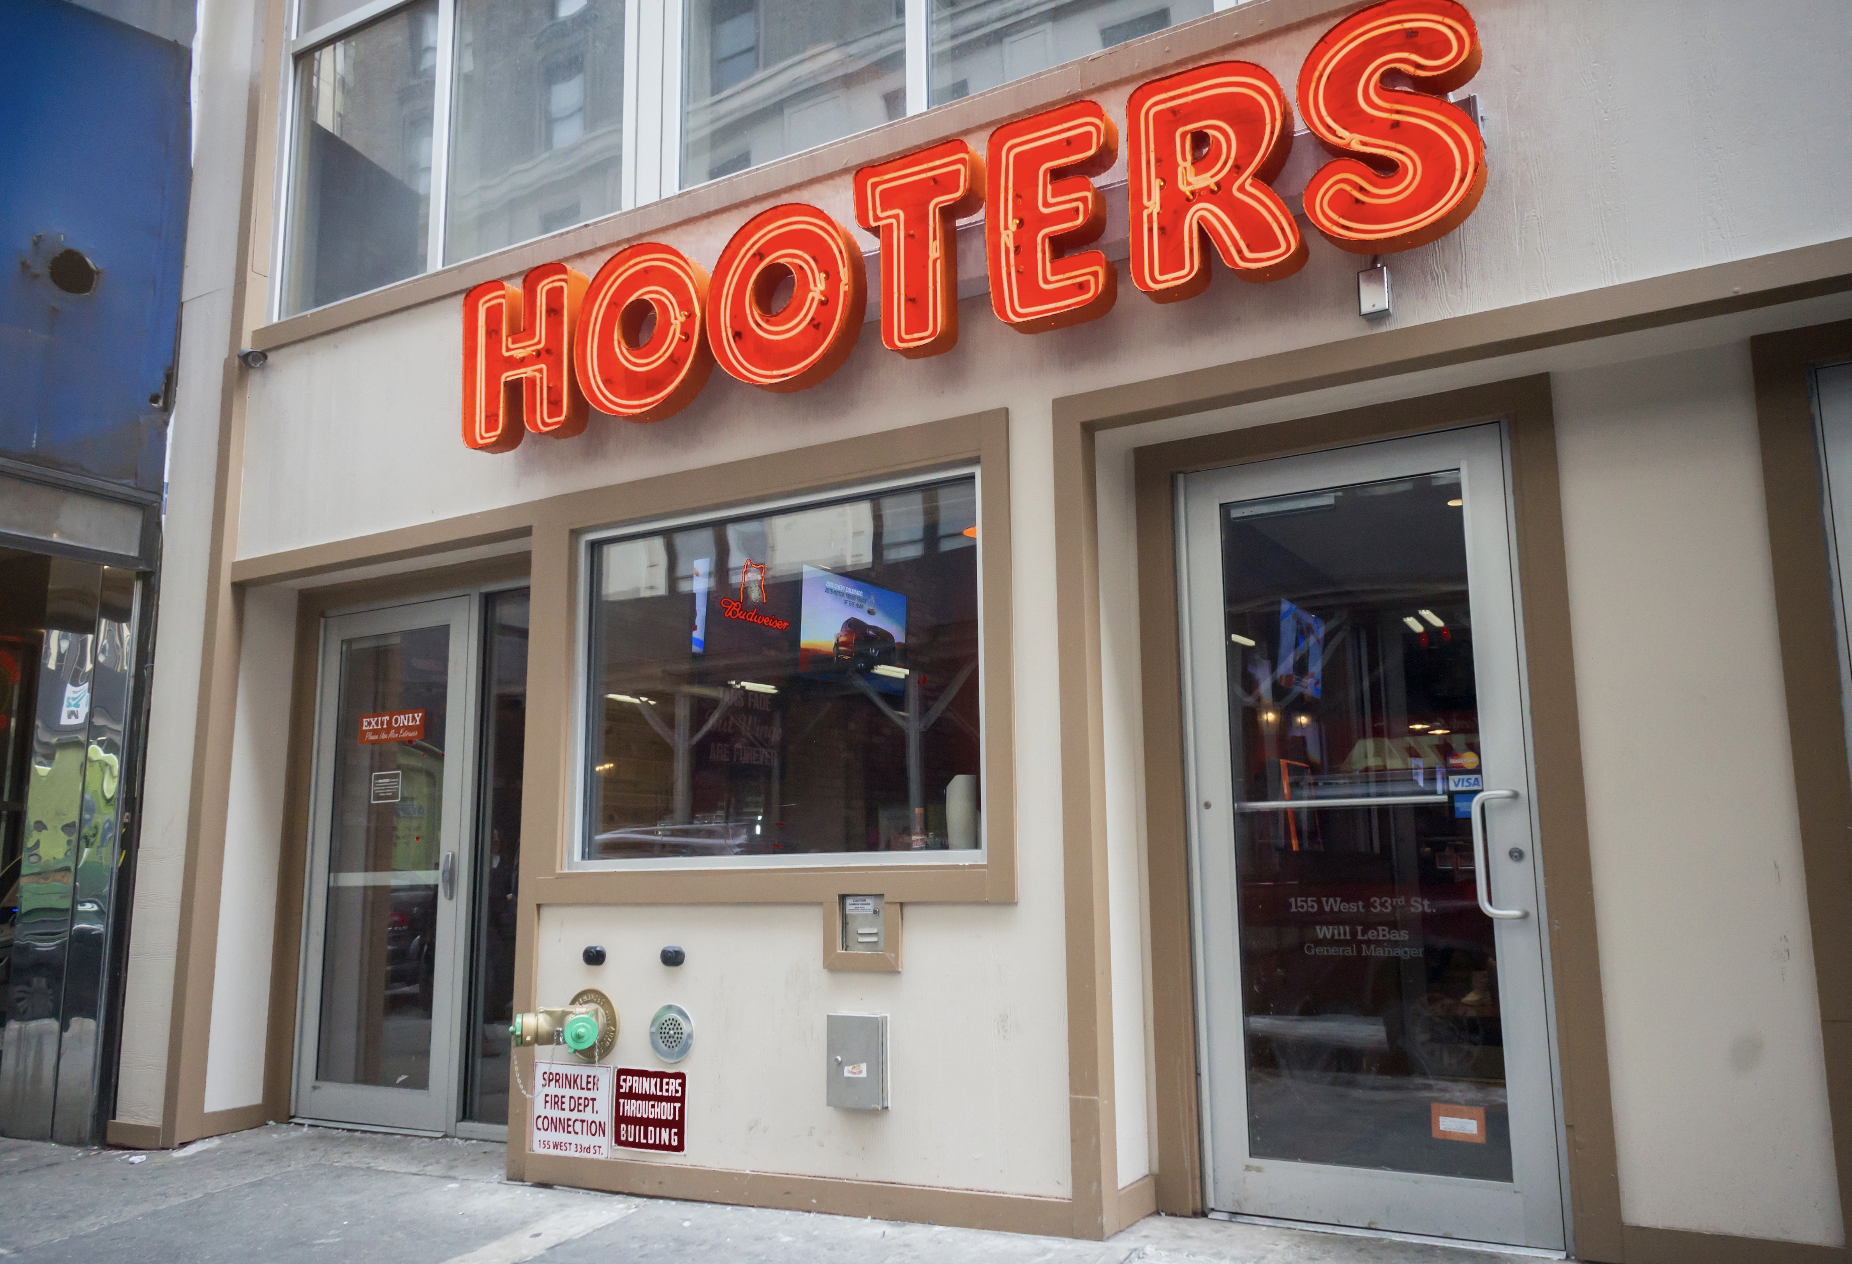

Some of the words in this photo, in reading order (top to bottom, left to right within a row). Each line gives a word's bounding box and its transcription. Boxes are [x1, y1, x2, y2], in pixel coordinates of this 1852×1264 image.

[463, 0, 1484, 452] HOOTERS
[720, 598, 790, 631] Budweiser
[362, 716, 390, 730] EXIT
[392, 712, 423, 727] ONLY
[1453, 777, 1481, 788] VISA
[1288, 897, 1318, 913] 155
[1321, 897, 1366, 913] West
[1369, 896, 1405, 913] 33rd
[1409, 896, 1437, 913] St.
[1315, 925, 1351, 940] Will
[1355, 926, 1410, 940] LeBas
[1304, 943, 1357, 956] General
[1361, 944, 1424, 959] Manager
[541, 1071, 599, 1092] SPRINKLER
[619, 1075, 682, 1097] SPRINKLERS
[543, 1093, 566, 1111] FIRE
[568, 1095, 599, 1115] DEPT.
[619, 1098, 681, 1121] THROUGHOUT
[535, 1115, 606, 1138] CONNECTION
[620, 1123, 678, 1146] BUILDING
[538, 1139, 551, 1150] 155
[552, 1140, 573, 1152] WEST
[574, 1142, 591, 1154] 33rd
[592, 1145, 604, 1156] ST.
